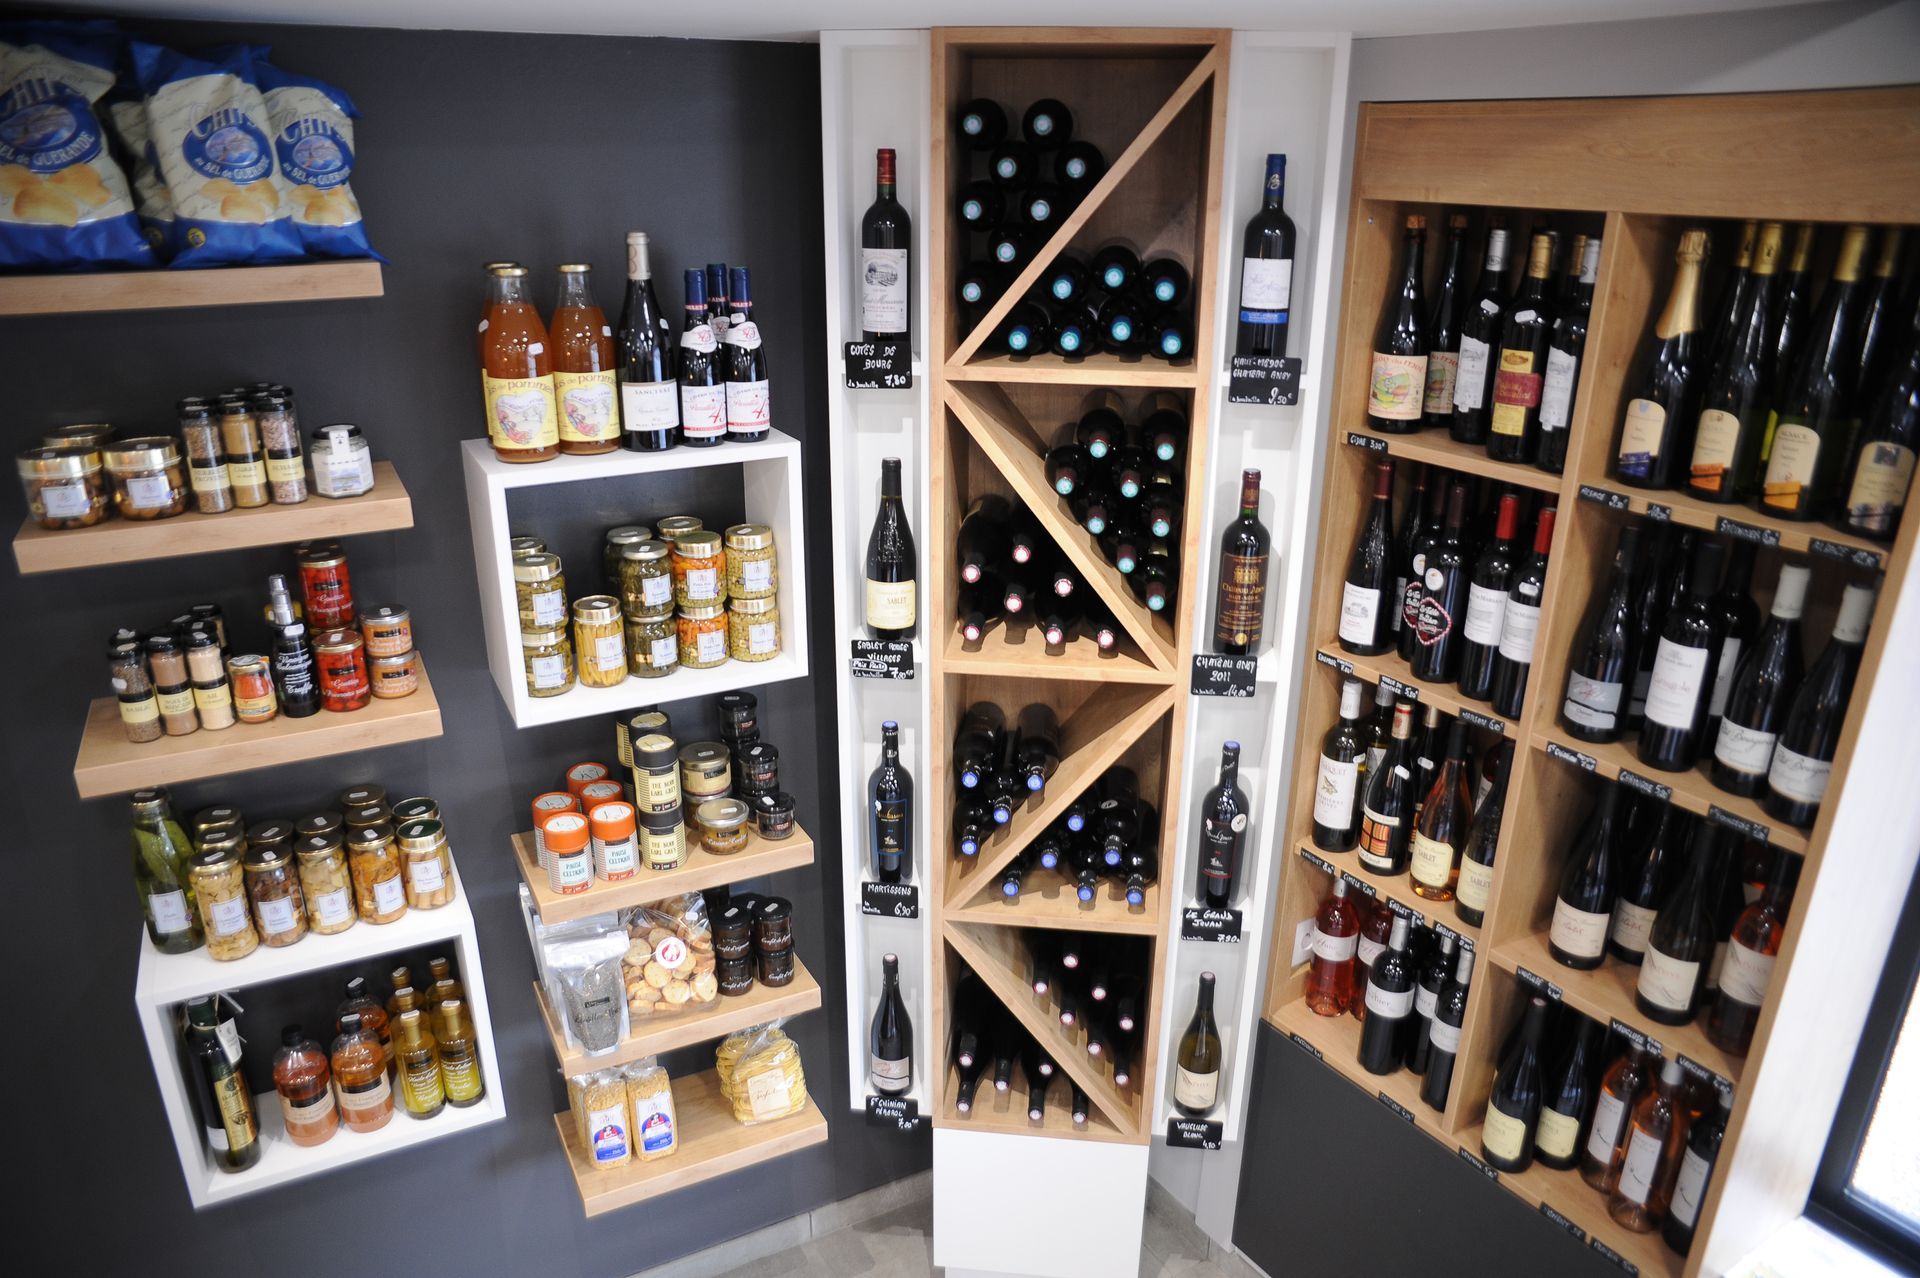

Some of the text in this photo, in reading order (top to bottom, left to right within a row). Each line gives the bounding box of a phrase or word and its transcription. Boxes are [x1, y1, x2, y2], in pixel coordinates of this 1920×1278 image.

[203, 162, 222, 176] SEL
[291, 167, 308, 183] SEL
[883, 346, 897, 357] DE
[863, 359, 893, 371] BOURG
[1210, 670, 1231, 682] 2011
[1185, 910, 1233, 920] LE GRAND
[1192, 918, 1222, 928] JOUAN
